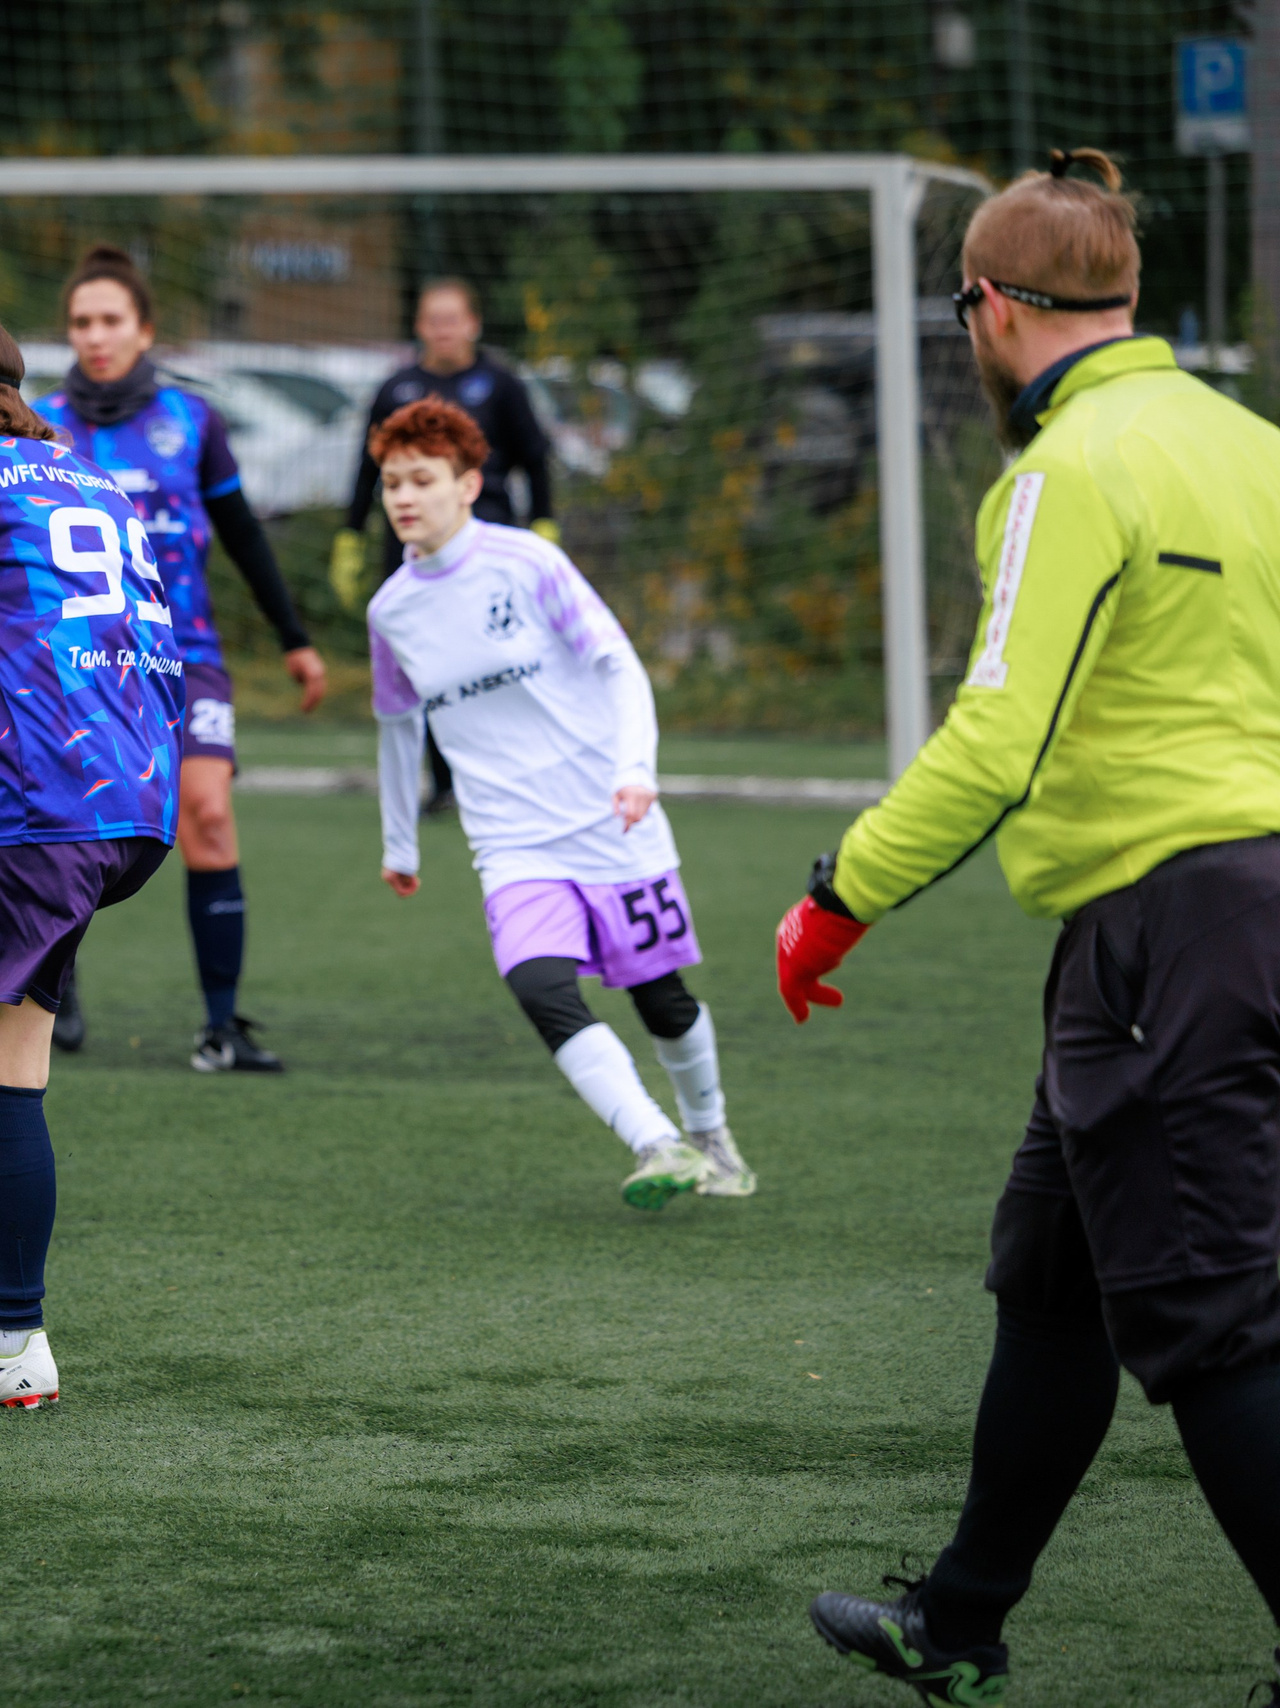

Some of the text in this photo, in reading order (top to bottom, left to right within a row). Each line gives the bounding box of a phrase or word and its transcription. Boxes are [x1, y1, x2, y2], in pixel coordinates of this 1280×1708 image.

[1195, 42, 1234, 113] P
[49, 507, 173, 629] 99
[68, 646, 111, 669] Там,
[117, 649, 137, 667] где
[622, 878, 687, 951] 55
